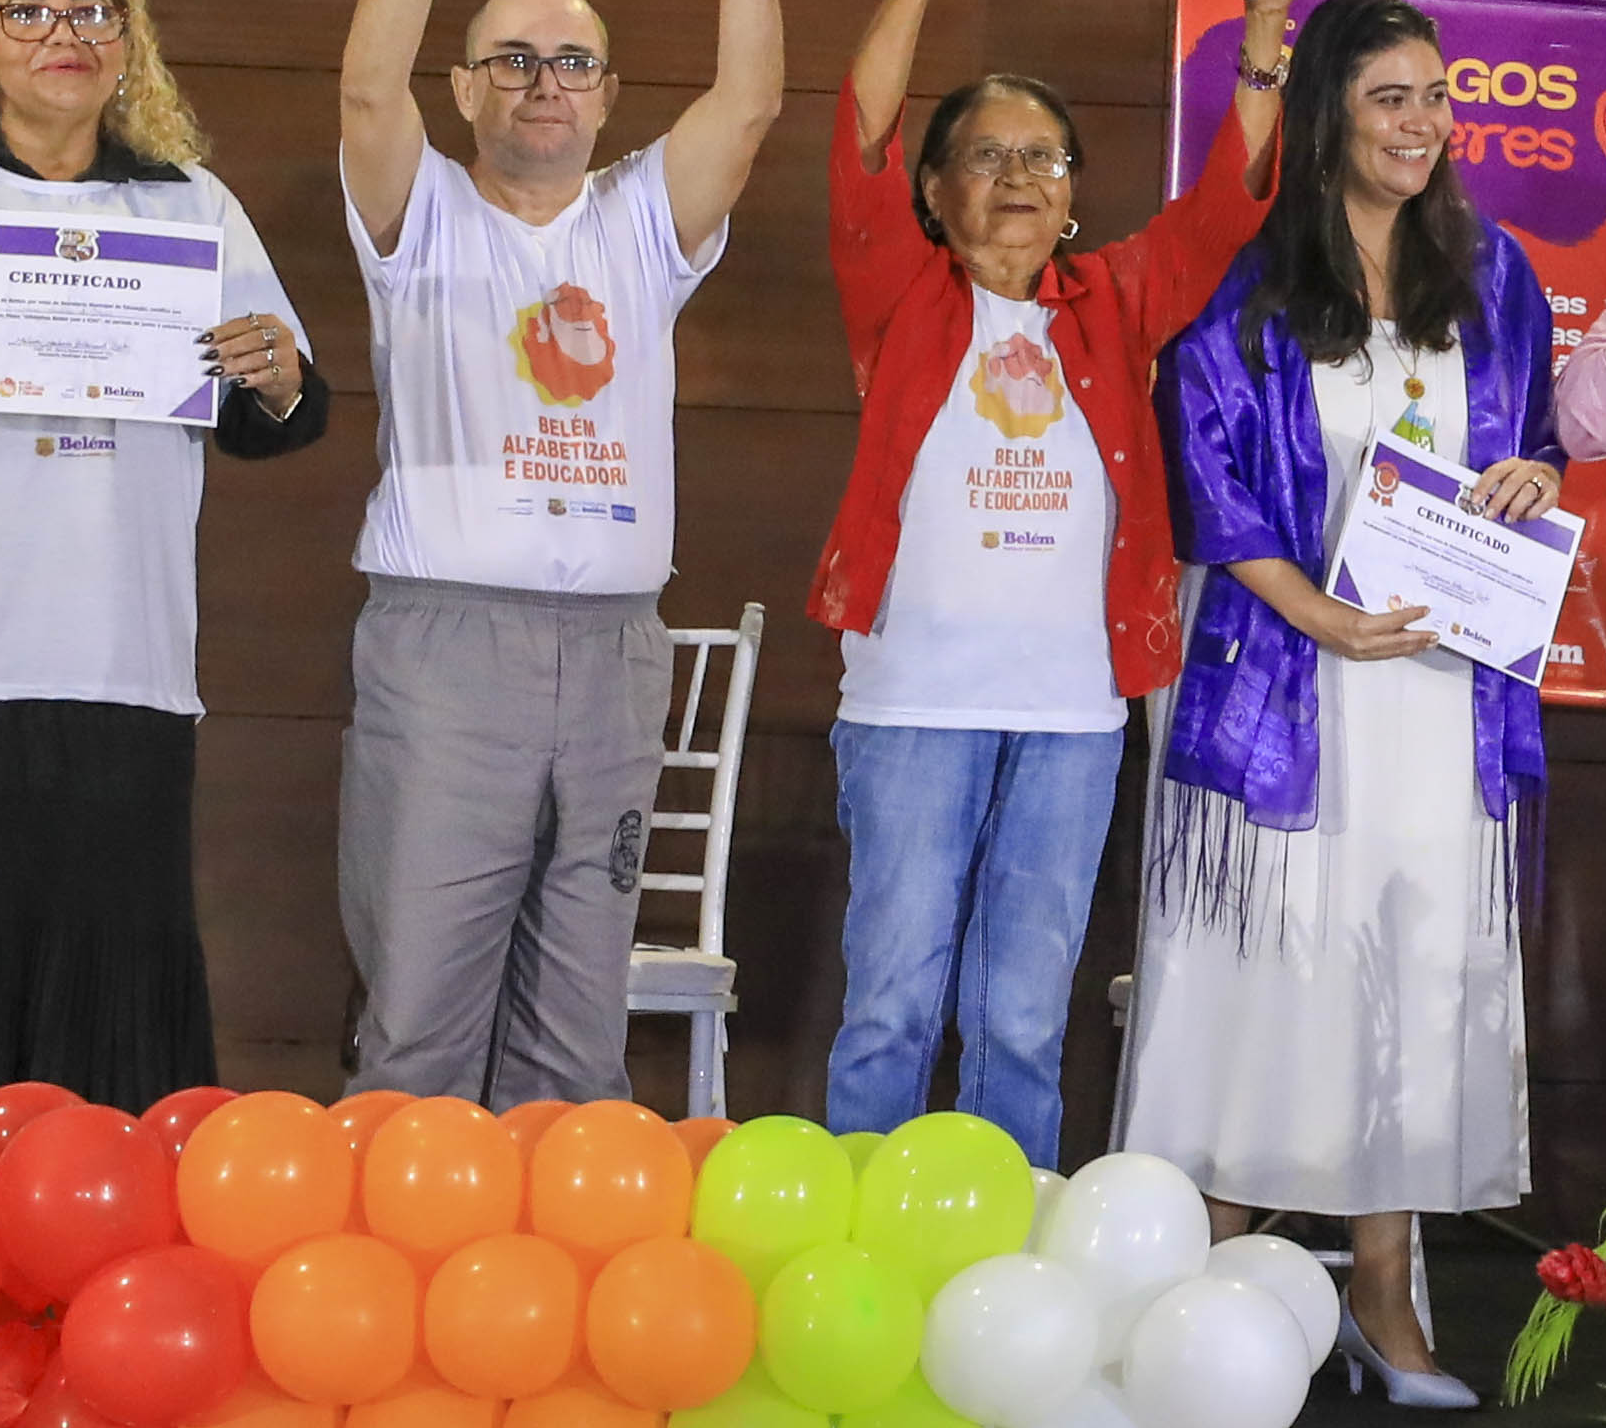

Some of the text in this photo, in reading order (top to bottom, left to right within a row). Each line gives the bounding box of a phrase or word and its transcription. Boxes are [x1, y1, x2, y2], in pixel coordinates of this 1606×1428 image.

[8, 270, 142, 291] CERTIFICADO
[103, 385, 145, 398] Belém
[538, 414, 596, 438] BELÉM
[59, 435, 116, 450] Belém
[995, 446, 1045, 468] BELÉM
[504, 460, 516, 480] E
[966, 466, 1073, 490] ALFABETIZADA
[969, 490, 1069, 512] E EDUCADORA
[1003, 530, 1055, 545] Belém
[1416, 505, 1511, 555] CERTIFICADO
[1462, 626, 1492, 647] Belém
